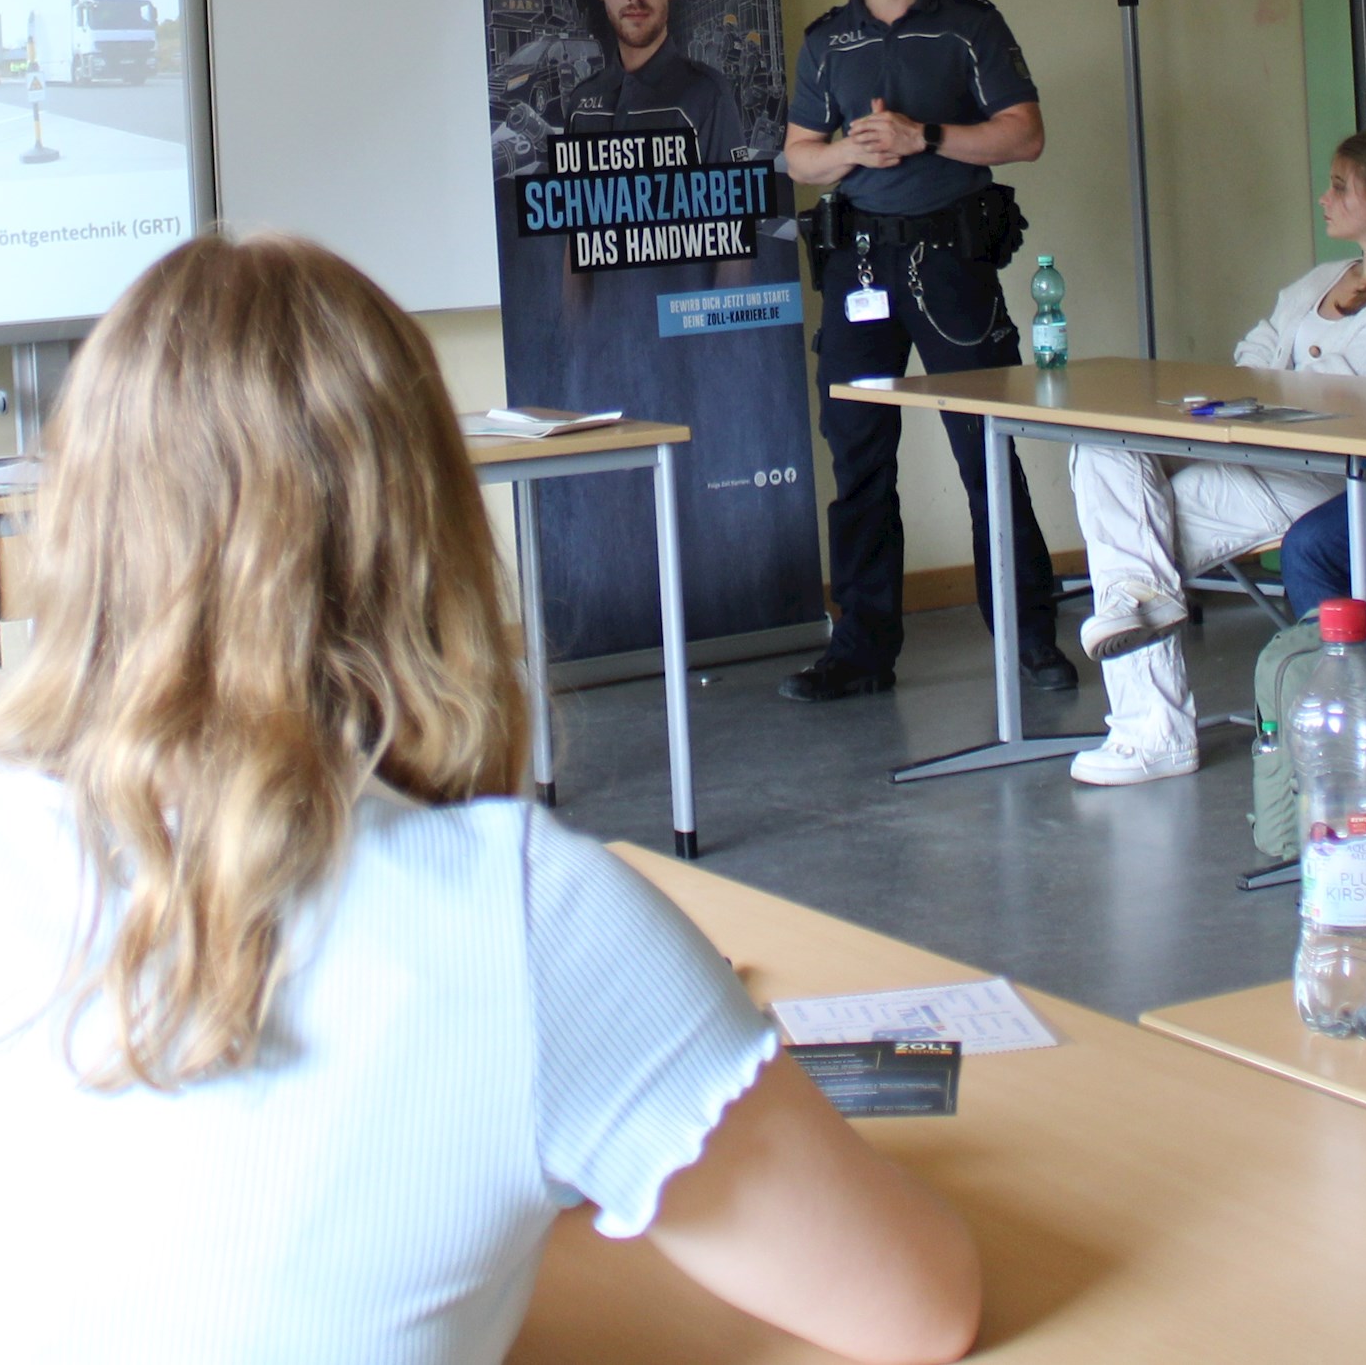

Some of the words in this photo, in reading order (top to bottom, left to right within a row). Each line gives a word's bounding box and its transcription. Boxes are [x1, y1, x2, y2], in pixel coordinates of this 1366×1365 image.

[829, 30, 865, 45] ZOLL
[578, 96, 604, 109] ZOLL
[556, 141, 581, 173] DU
[587, 138, 645, 172] LEGST
[652, 136, 687, 168] DER
[525, 167, 768, 230] SCHWARZARBEIT
[132, 217, 182, 239] (GRT)
[577, 230, 618, 267] DAS
[625, 221, 751, 263] HANDWERK.
[670, 299, 701, 314] BEWIRB
[702, 297, 721, 311] DICH
[722, 295, 744, 309] JETZT
[746, 293, 762, 306] UND
[763, 289, 791, 304] STARTE
[682, 315, 705, 329] DEINE
[707, 307, 780, 326] ZOLL-KARRIERE.DE
[895, 1042, 953, 1050] ZOLL
